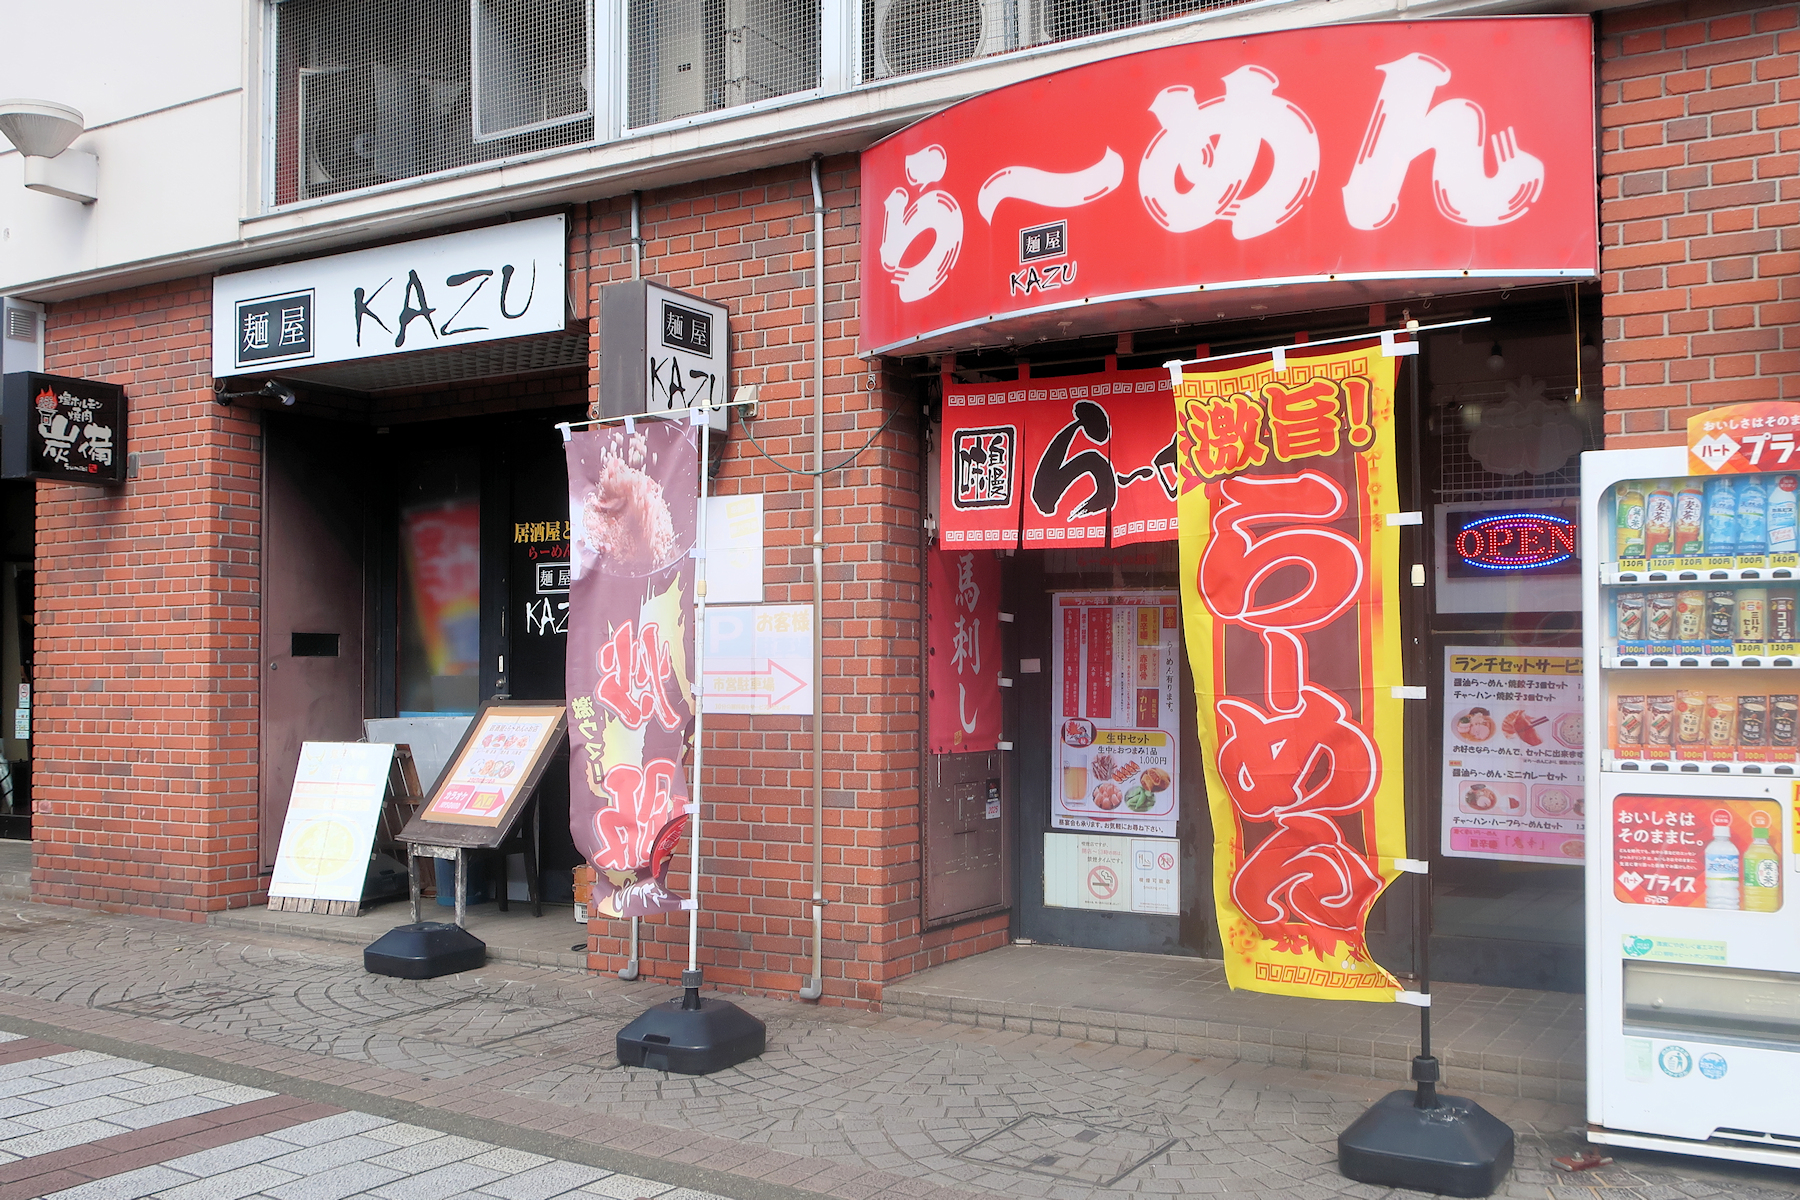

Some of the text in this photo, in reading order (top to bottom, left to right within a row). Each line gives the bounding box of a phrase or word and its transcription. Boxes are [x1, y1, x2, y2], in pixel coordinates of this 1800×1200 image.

[1024, 226, 1064, 256] 麺屋
[1009, 261, 1077, 296] KAZU
[353, 258, 537, 349] KAZU
[242, 305, 307, 352] 麺屋
[665, 311, 708, 347] 麺屋
[650, 356, 726, 413] KAZU
[67, 406, 94, 423] 焼肉
[1702, 444, 1730, 458] ハート
[1742, 432, 1800, 465] プラ
[1455, 525, 1577, 558] OPEN
[1680, 558, 1702, 566] 120円
[1772, 555, 1795, 563] 140円
[756, 609, 811, 633] お客様
[1777, 611, 1787, 637] ココア
[709, 615, 743, 653] P
[950, 551, 981, 734] 馬刺し
[1738, 644, 1760, 652] 130円
[1455, 656, 1584, 674] ランチセットサービ
[713, 677, 775, 692] 市営駐車場
[1139, 695, 1148, 721] カレー
[1106, 733, 1150, 744] 生中セット
[1618, 809, 1696, 827] おいしさは
[1618, 828, 1704, 846] そのままに。
[1643, 874, 1697, 893] プライス
